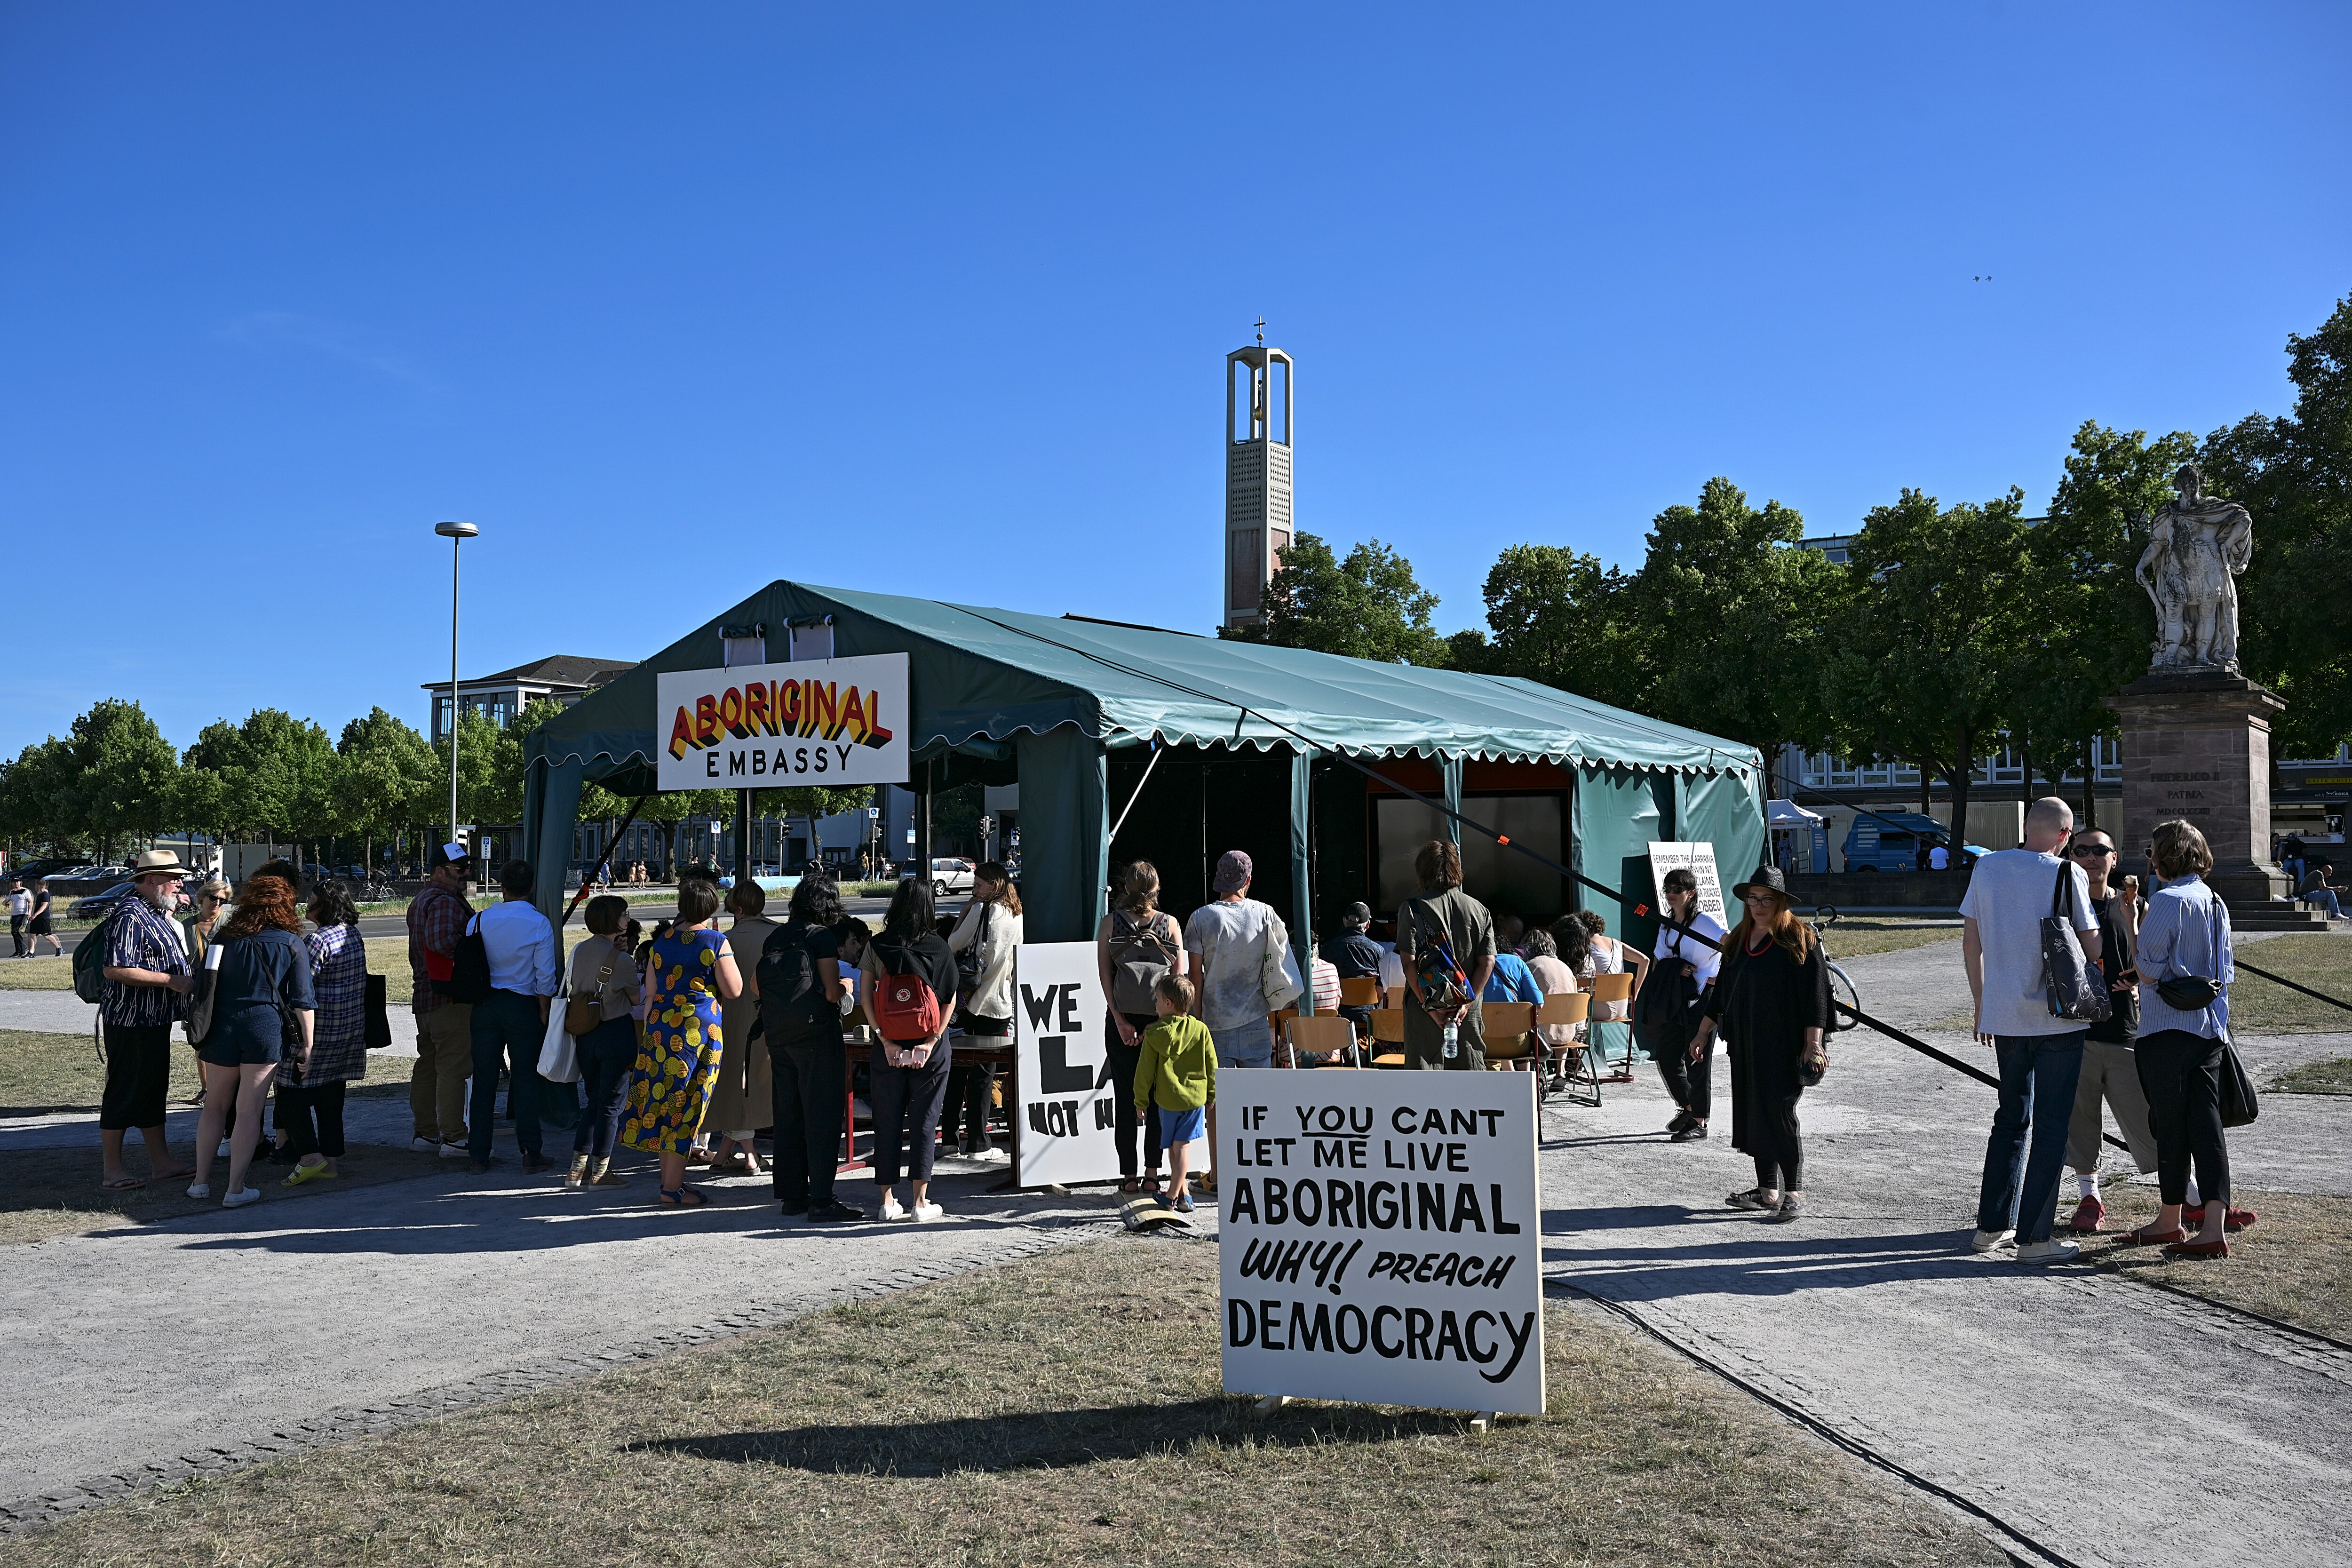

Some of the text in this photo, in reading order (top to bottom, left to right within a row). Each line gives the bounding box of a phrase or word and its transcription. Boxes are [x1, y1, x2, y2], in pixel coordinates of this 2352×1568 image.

[668, 678, 892, 762] ABORIGINAL
[707, 744, 852, 778] EMBASSY
[2151, 772, 2209, 782] FRIDERICO
[2167, 790, 2204, 799] PATRIA
[1653, 854, 1714, 863] REMEMBER THE LARRAKIA
[1696, 876, 1715, 886] CLAIMS
[1698, 899, 1721, 912] OBBED
[1019, 983, 1082, 1033] WE
[1028, 1100, 1079, 1138] NOT
[1242, 1105, 1505, 1137] IF YOU CANT
[1237, 1138, 1469, 1172] LET ME LIVE
[1229, 1177, 1521, 1234] ABORIGINAL
[1240, 1237, 1517, 1296] WHY! PREACH
[1228, 1298, 1535, 1384] DEMOCRACY
